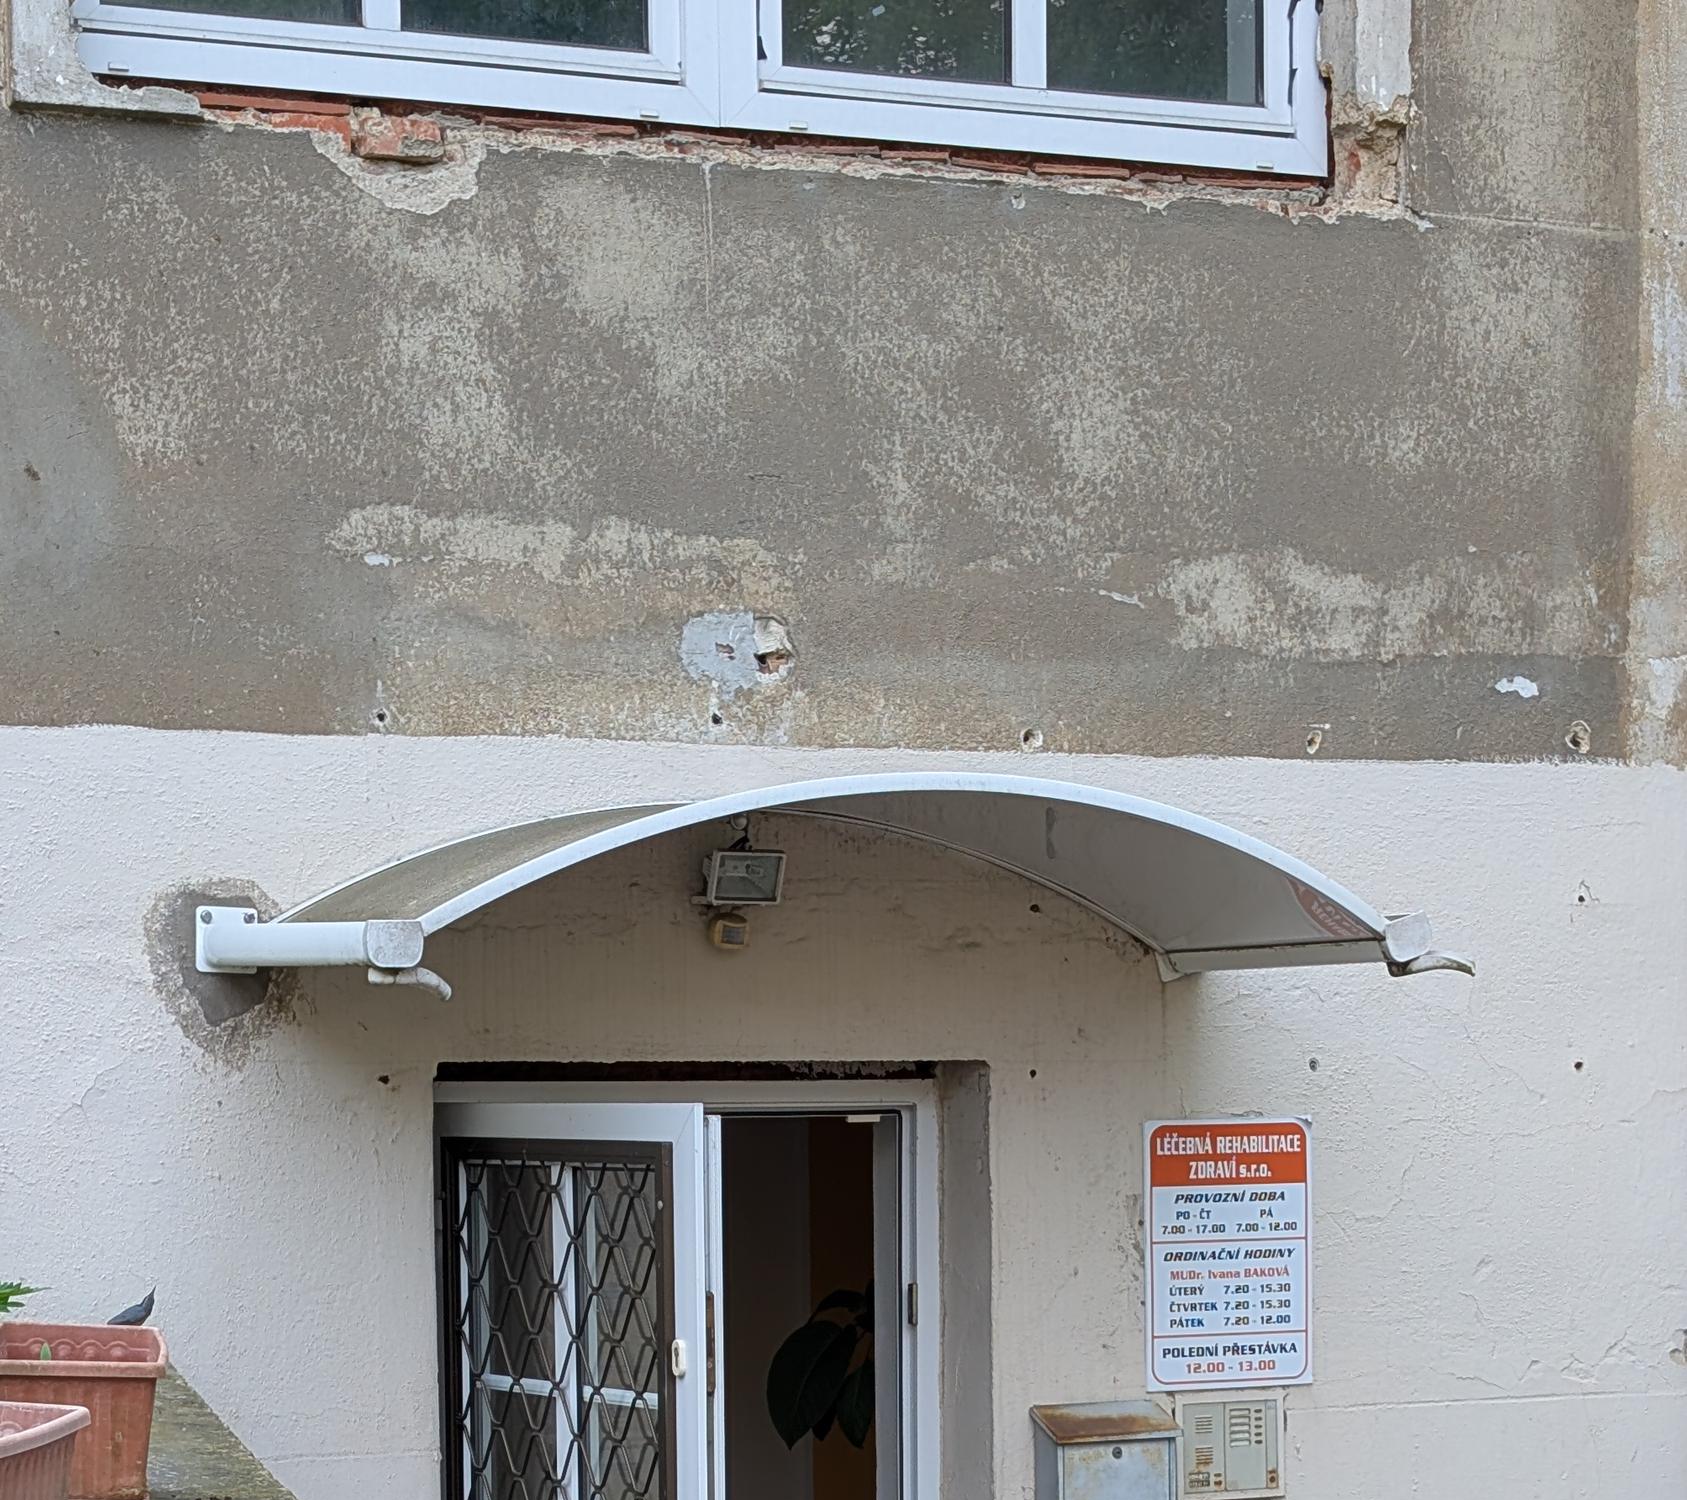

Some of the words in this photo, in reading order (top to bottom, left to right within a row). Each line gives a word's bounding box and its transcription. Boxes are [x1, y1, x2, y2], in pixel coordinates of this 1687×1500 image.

[1157, 1132, 1212, 1155] LÉČEBNÁ
[1217, 1135, 1301, 1153] REHABILITACE
[1189, 1156, 1236, 1179] ZDRAVÍ
[1240, 1164, 1272, 1177] s.r.o.
[1175, 1190, 1246, 1204] PROVOZNÍ
[1249, 1191, 1285, 1201] DOBA
[1176, 1211, 1190, 1220] PO
[1199, 1208, 1211, 1219] ČT
[1260, 1207, 1273, 1218] PÁ
[1162, 1225, 1185, 1234] 7.00
[1196, 1224, 1226, 1233] 17.00
[1236, 1223, 1258, 1232] 7.00
[1269, 1222, 1297, 1231] 12.00
[1164, 1248, 1241, 1262] ORDINAČNÍ
[1244, 1248, 1295, 1259] HODINY
[1170, 1270, 1204, 1281] MUDr.
[1208, 1269, 1240, 1279] Ivana
[1244, 1265, 1289, 1278] BAKOVÁ
[1169, 1284, 1205, 1296] ÚTERÝ
[1224, 1285, 1249, 1295] 7.20
[1260, 1283, 1290, 1293] 15.30
[1169, 1302, 1218, 1313] ČTVRTEK
[1224, 1301, 1249, 1311] 7.20
[1260, 1299, 1290, 1309] 15.30
[1170, 1317, 1204, 1328] PÁTEK
[1224, 1317, 1249, 1326] 7.20
[1260, 1315, 1290, 1325] 12.00
[1162, 1343, 1218, 1359] POLEDNÍ
[1222, 1341, 1297, 1356] PŘESTÁVKA
[1186, 1362, 1225, 1374] 12.00
[1238, 1360, 1276, 1371] 13.00
